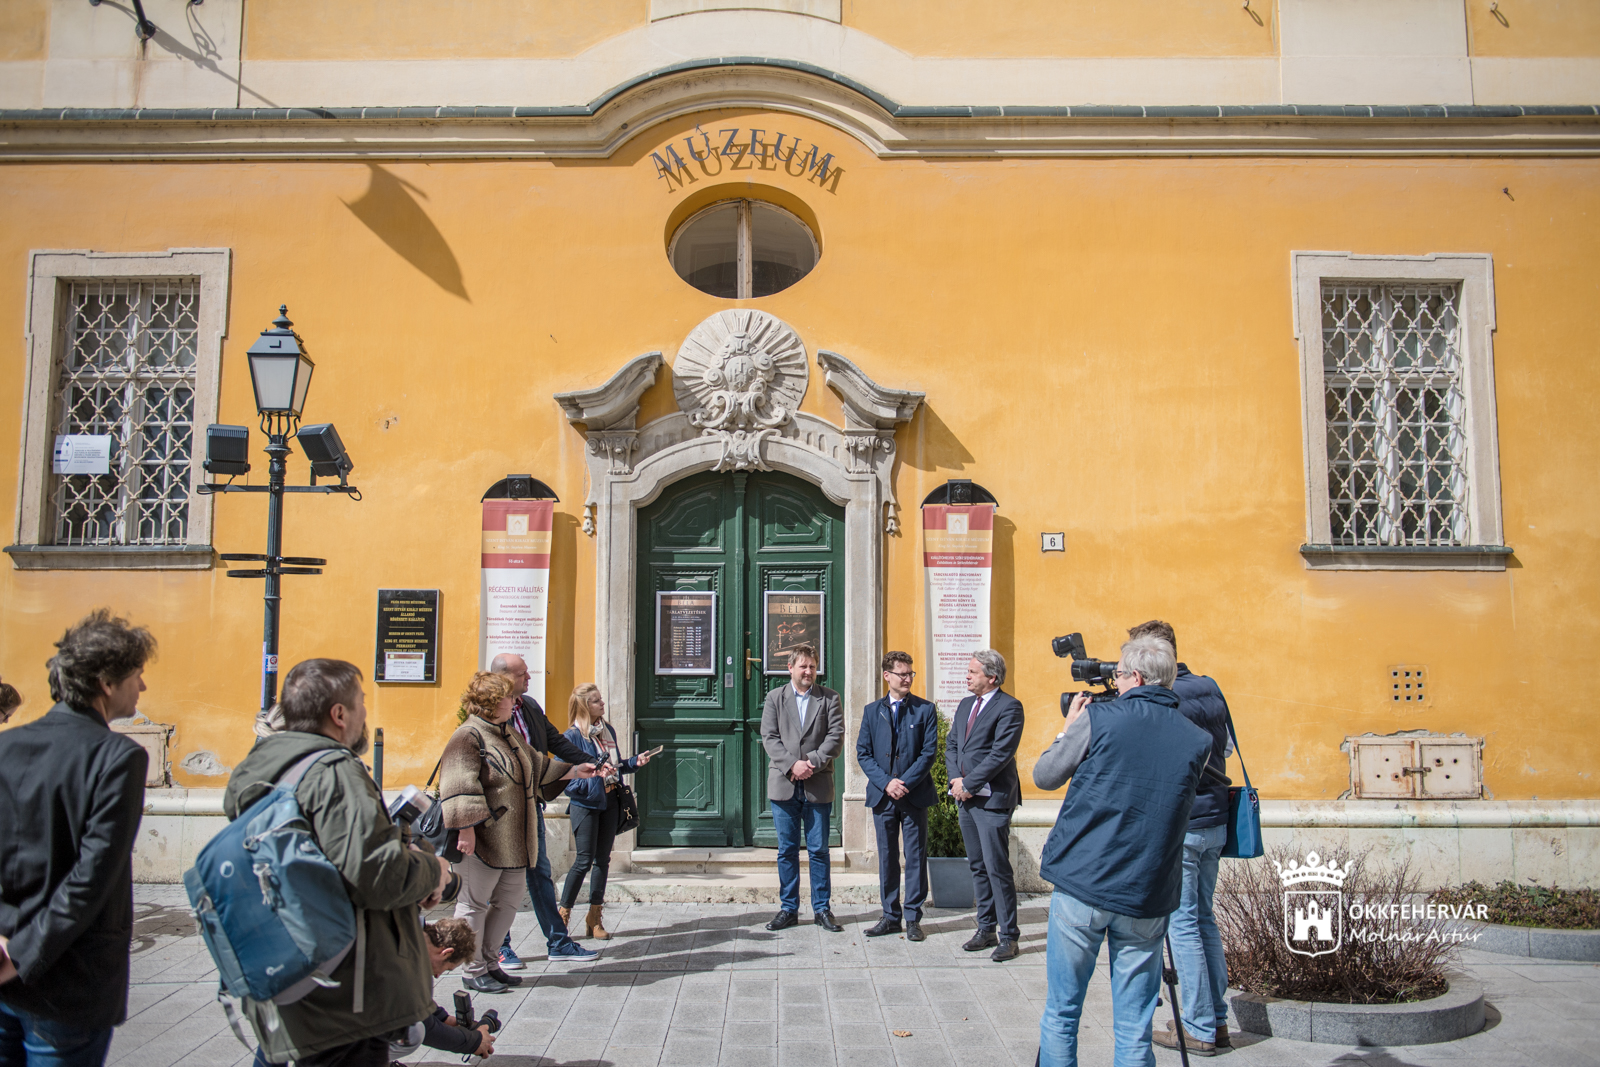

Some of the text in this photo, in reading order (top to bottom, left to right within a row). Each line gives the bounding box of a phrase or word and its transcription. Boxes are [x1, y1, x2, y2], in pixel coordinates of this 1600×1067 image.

[649, 124, 835, 180] MÚZEUM
[1050, 537, 1055, 547] 6
[488, 585, 544, 593] RÉGÉSZETI KIÁLLÍTÁS
[780, 604, 808, 613] BÉLA
